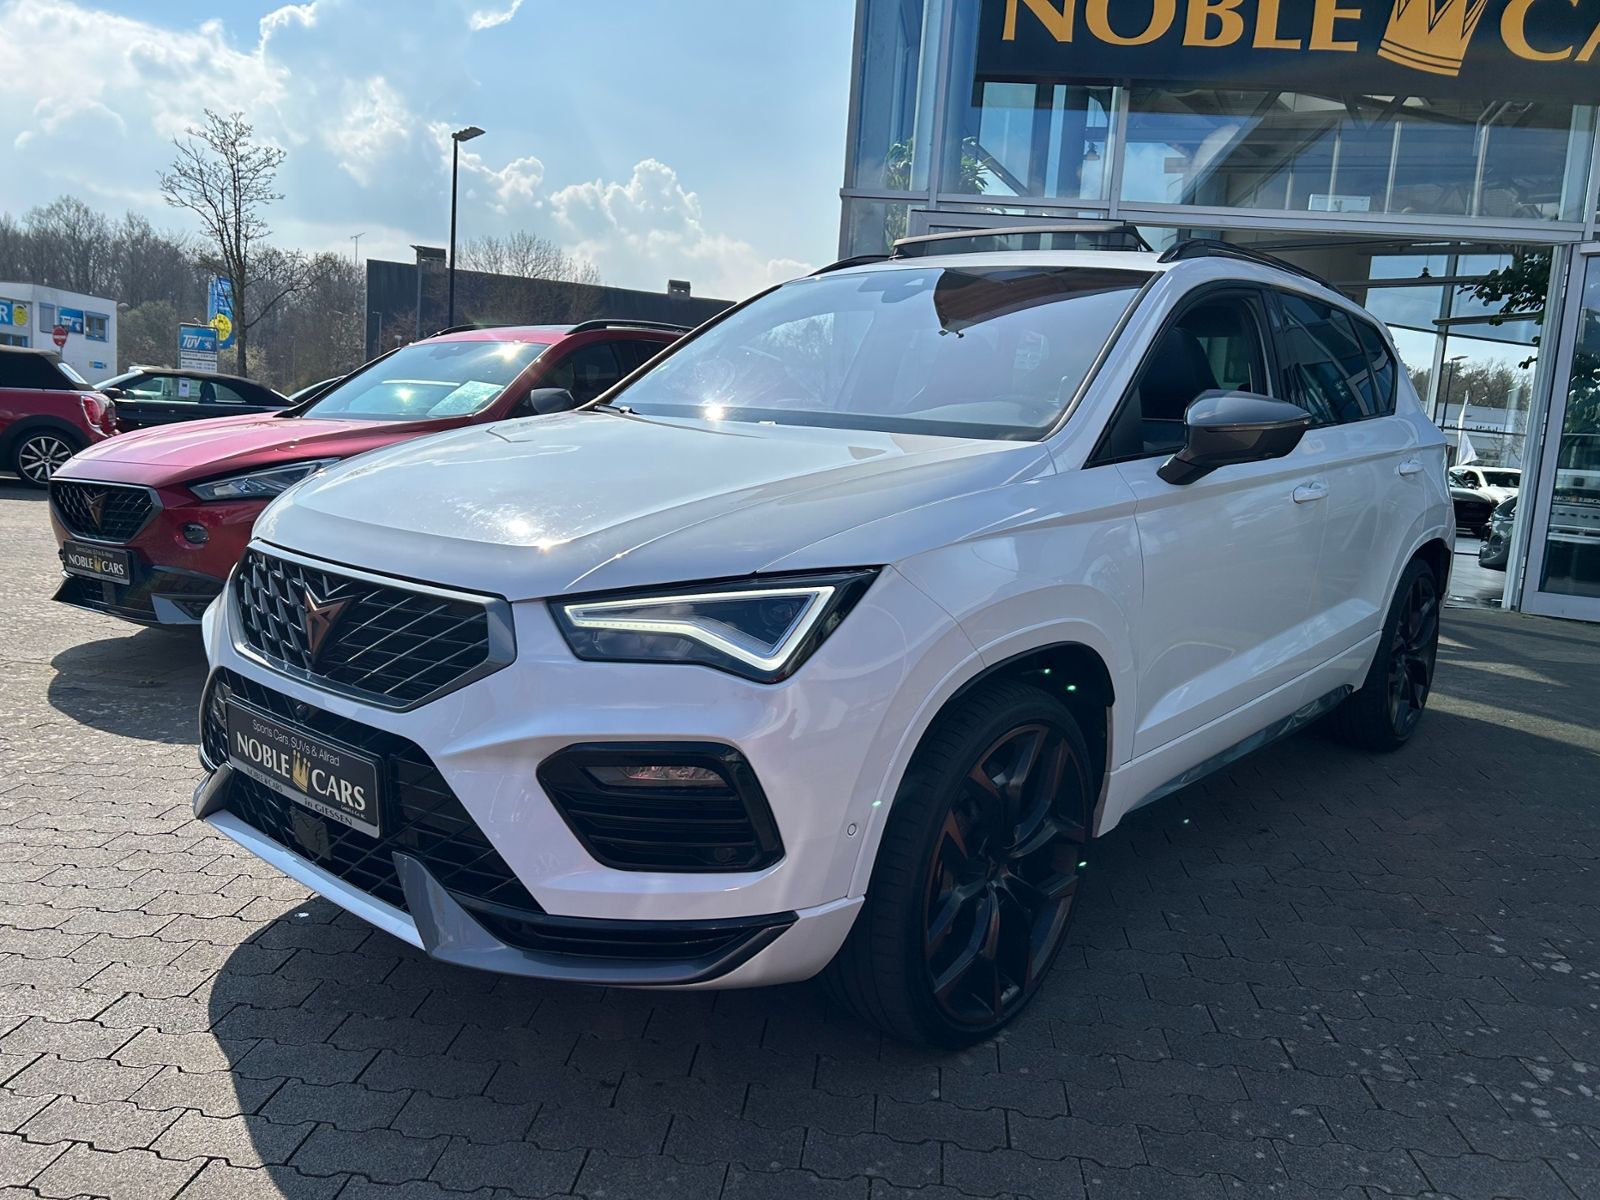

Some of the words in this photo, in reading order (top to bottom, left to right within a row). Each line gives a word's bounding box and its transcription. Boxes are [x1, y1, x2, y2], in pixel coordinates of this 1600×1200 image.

[1002, 0, 1358, 52] NOBLE
[183, 335, 201, 348] TÜV
[68, 553, 94, 569] NOBLE
[102, 561, 124, 575] CARS
[311, 745, 317, 757] &
[318, 748, 340, 767] Allrad
[236, 731, 290, 778] NOBLE
[311, 768, 366, 811] CARS
[304, 797, 313, 807] in
[315, 801, 353, 826] GIESSEN
